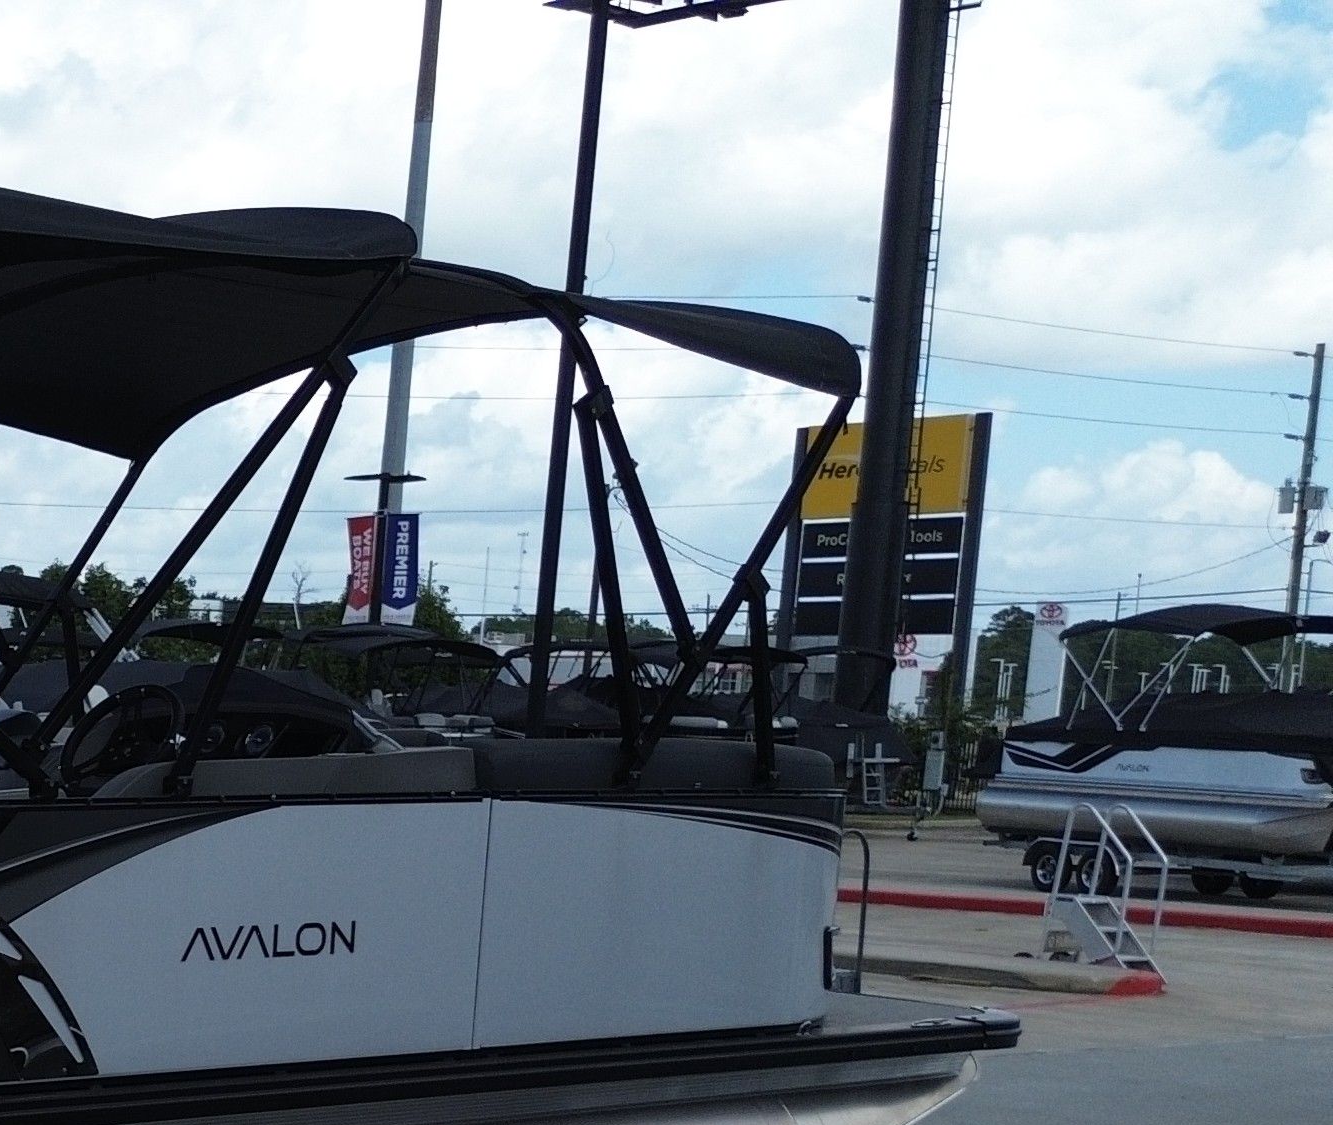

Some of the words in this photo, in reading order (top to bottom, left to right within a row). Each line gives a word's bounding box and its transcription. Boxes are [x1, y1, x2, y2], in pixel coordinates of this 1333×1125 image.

[362, 528, 372, 556] WE
[393, 521, 410, 599] PREMIER
[352, 535, 362, 590] BOATS
[360, 561, 371, 594] BUY
[1115, 763, 1149, 772] AVALON
[181, 920, 356, 962] AVALON
